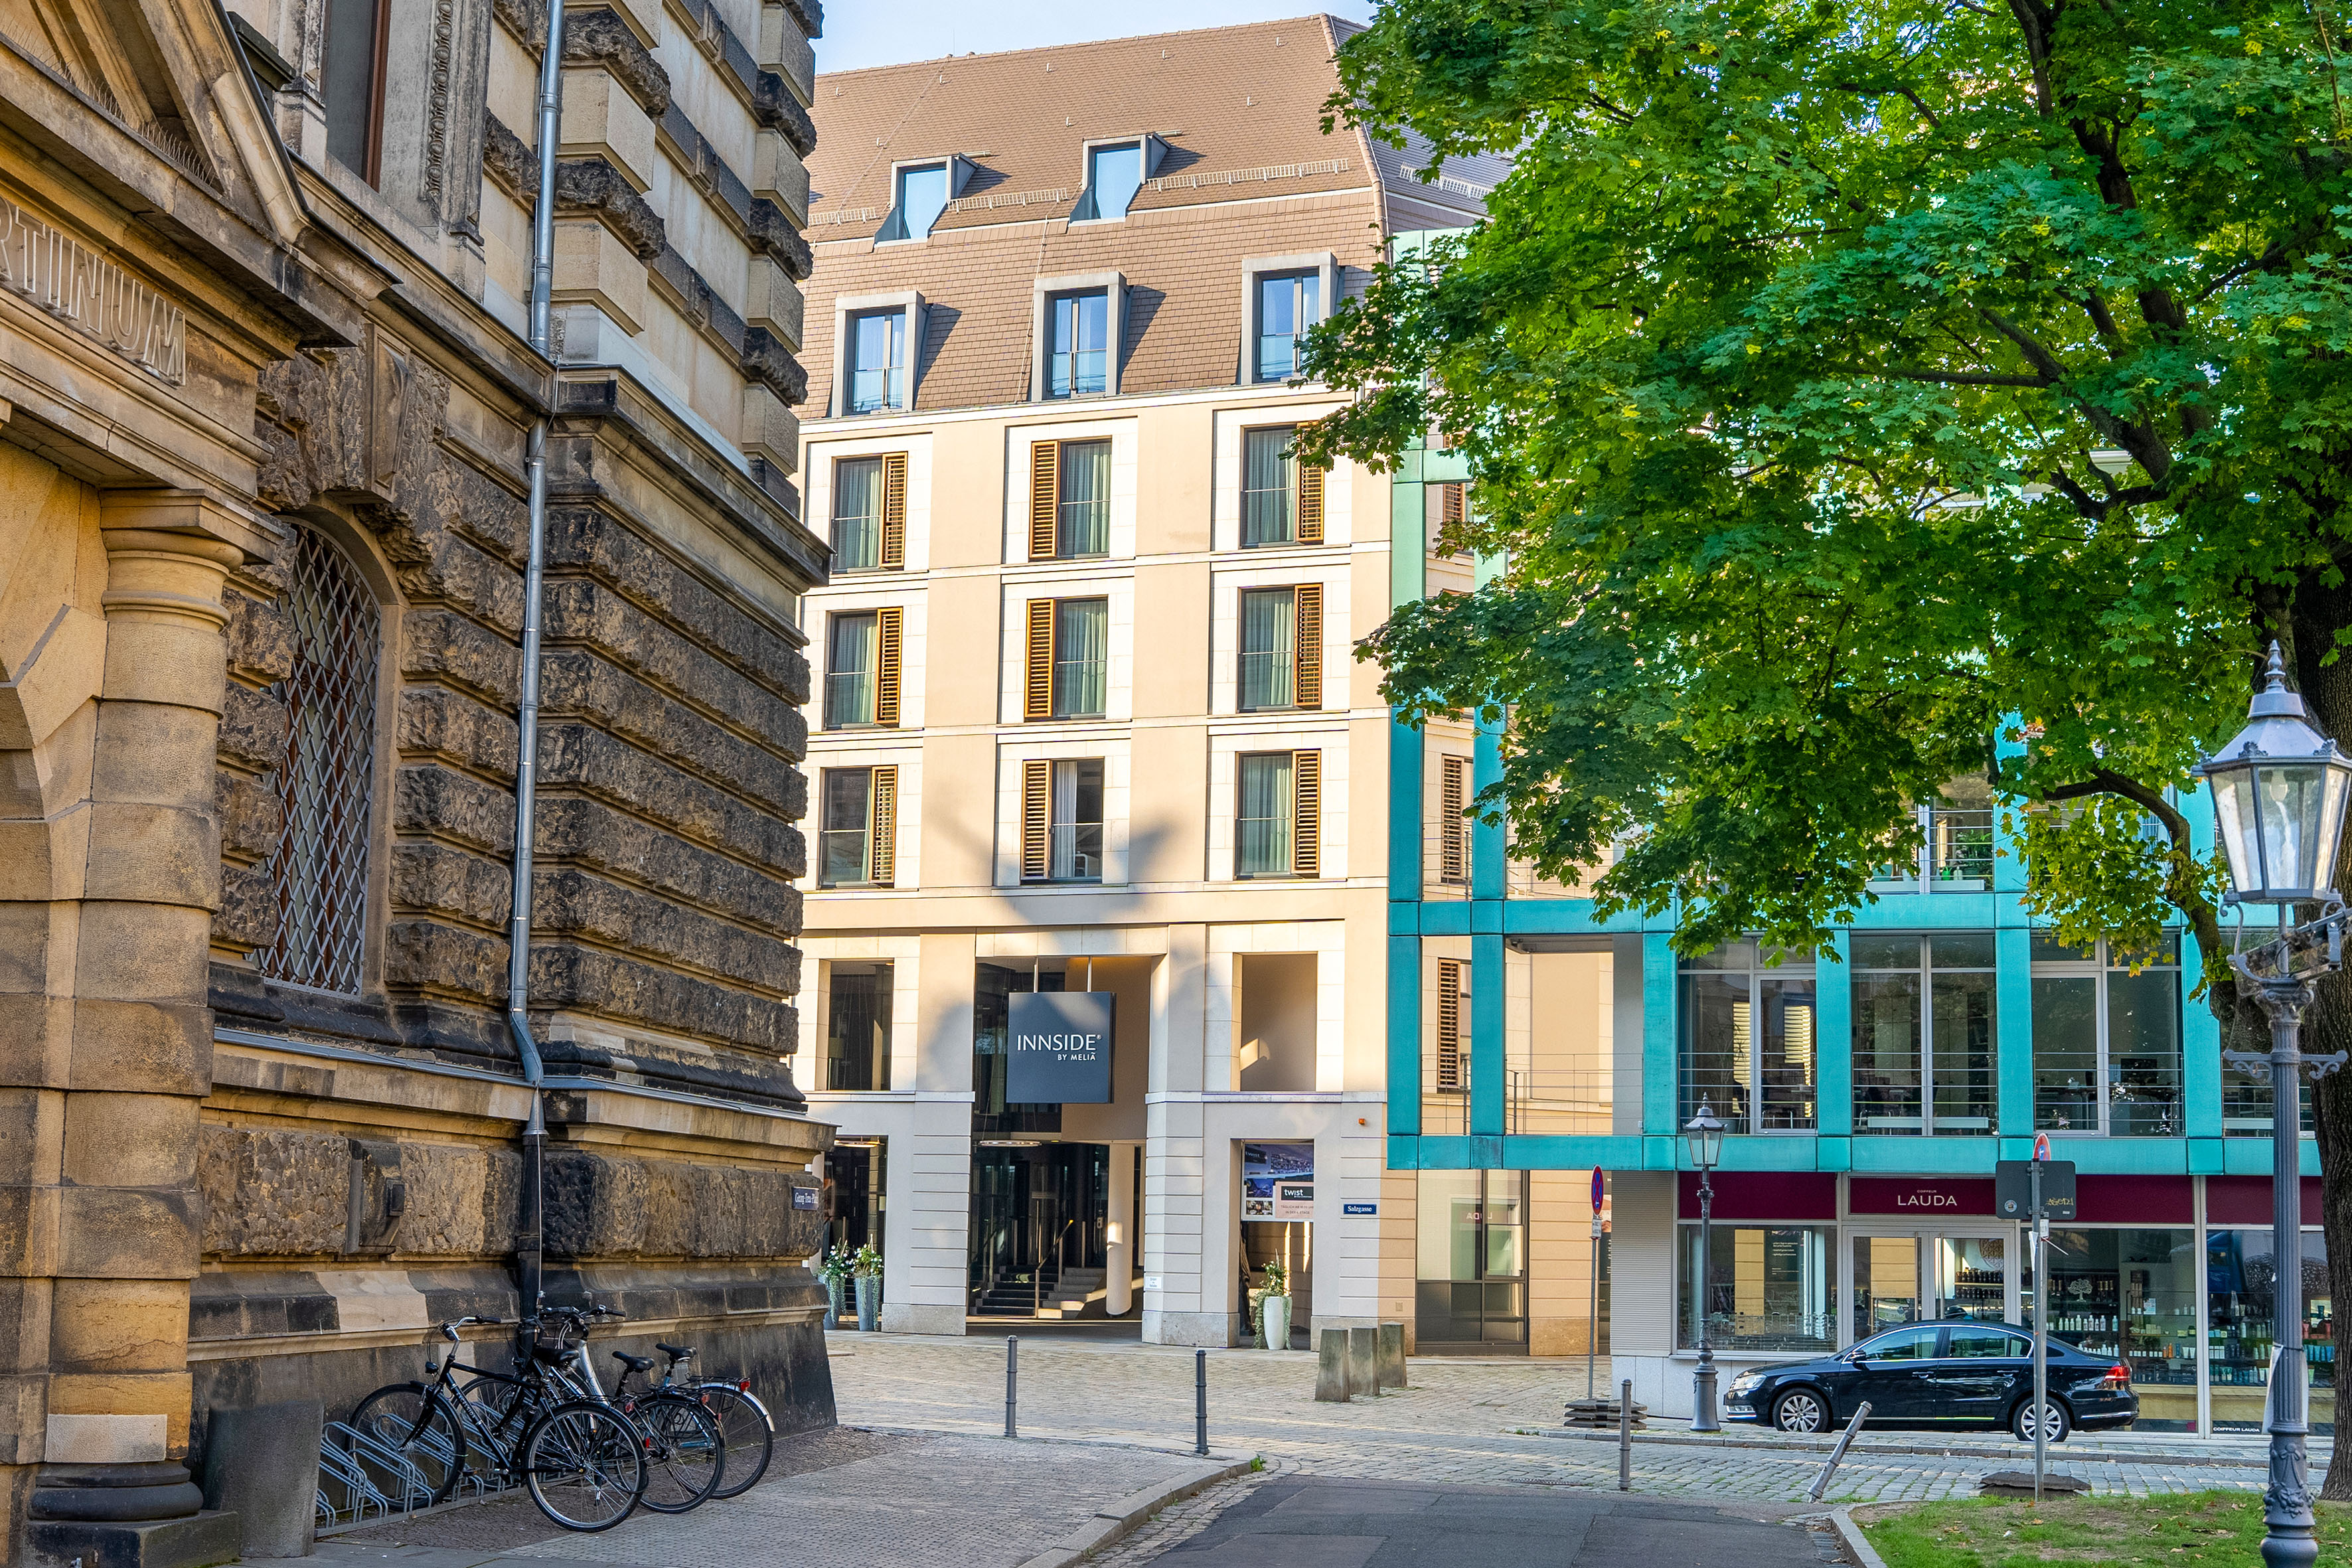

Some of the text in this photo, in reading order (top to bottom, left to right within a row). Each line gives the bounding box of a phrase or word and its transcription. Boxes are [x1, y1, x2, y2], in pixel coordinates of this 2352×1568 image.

[1284, 1188, 1304, 1198] twist
[1897, 1195, 1958, 1206] LAUDA
[1348, 1205, 1373, 1214] Salzgasse
